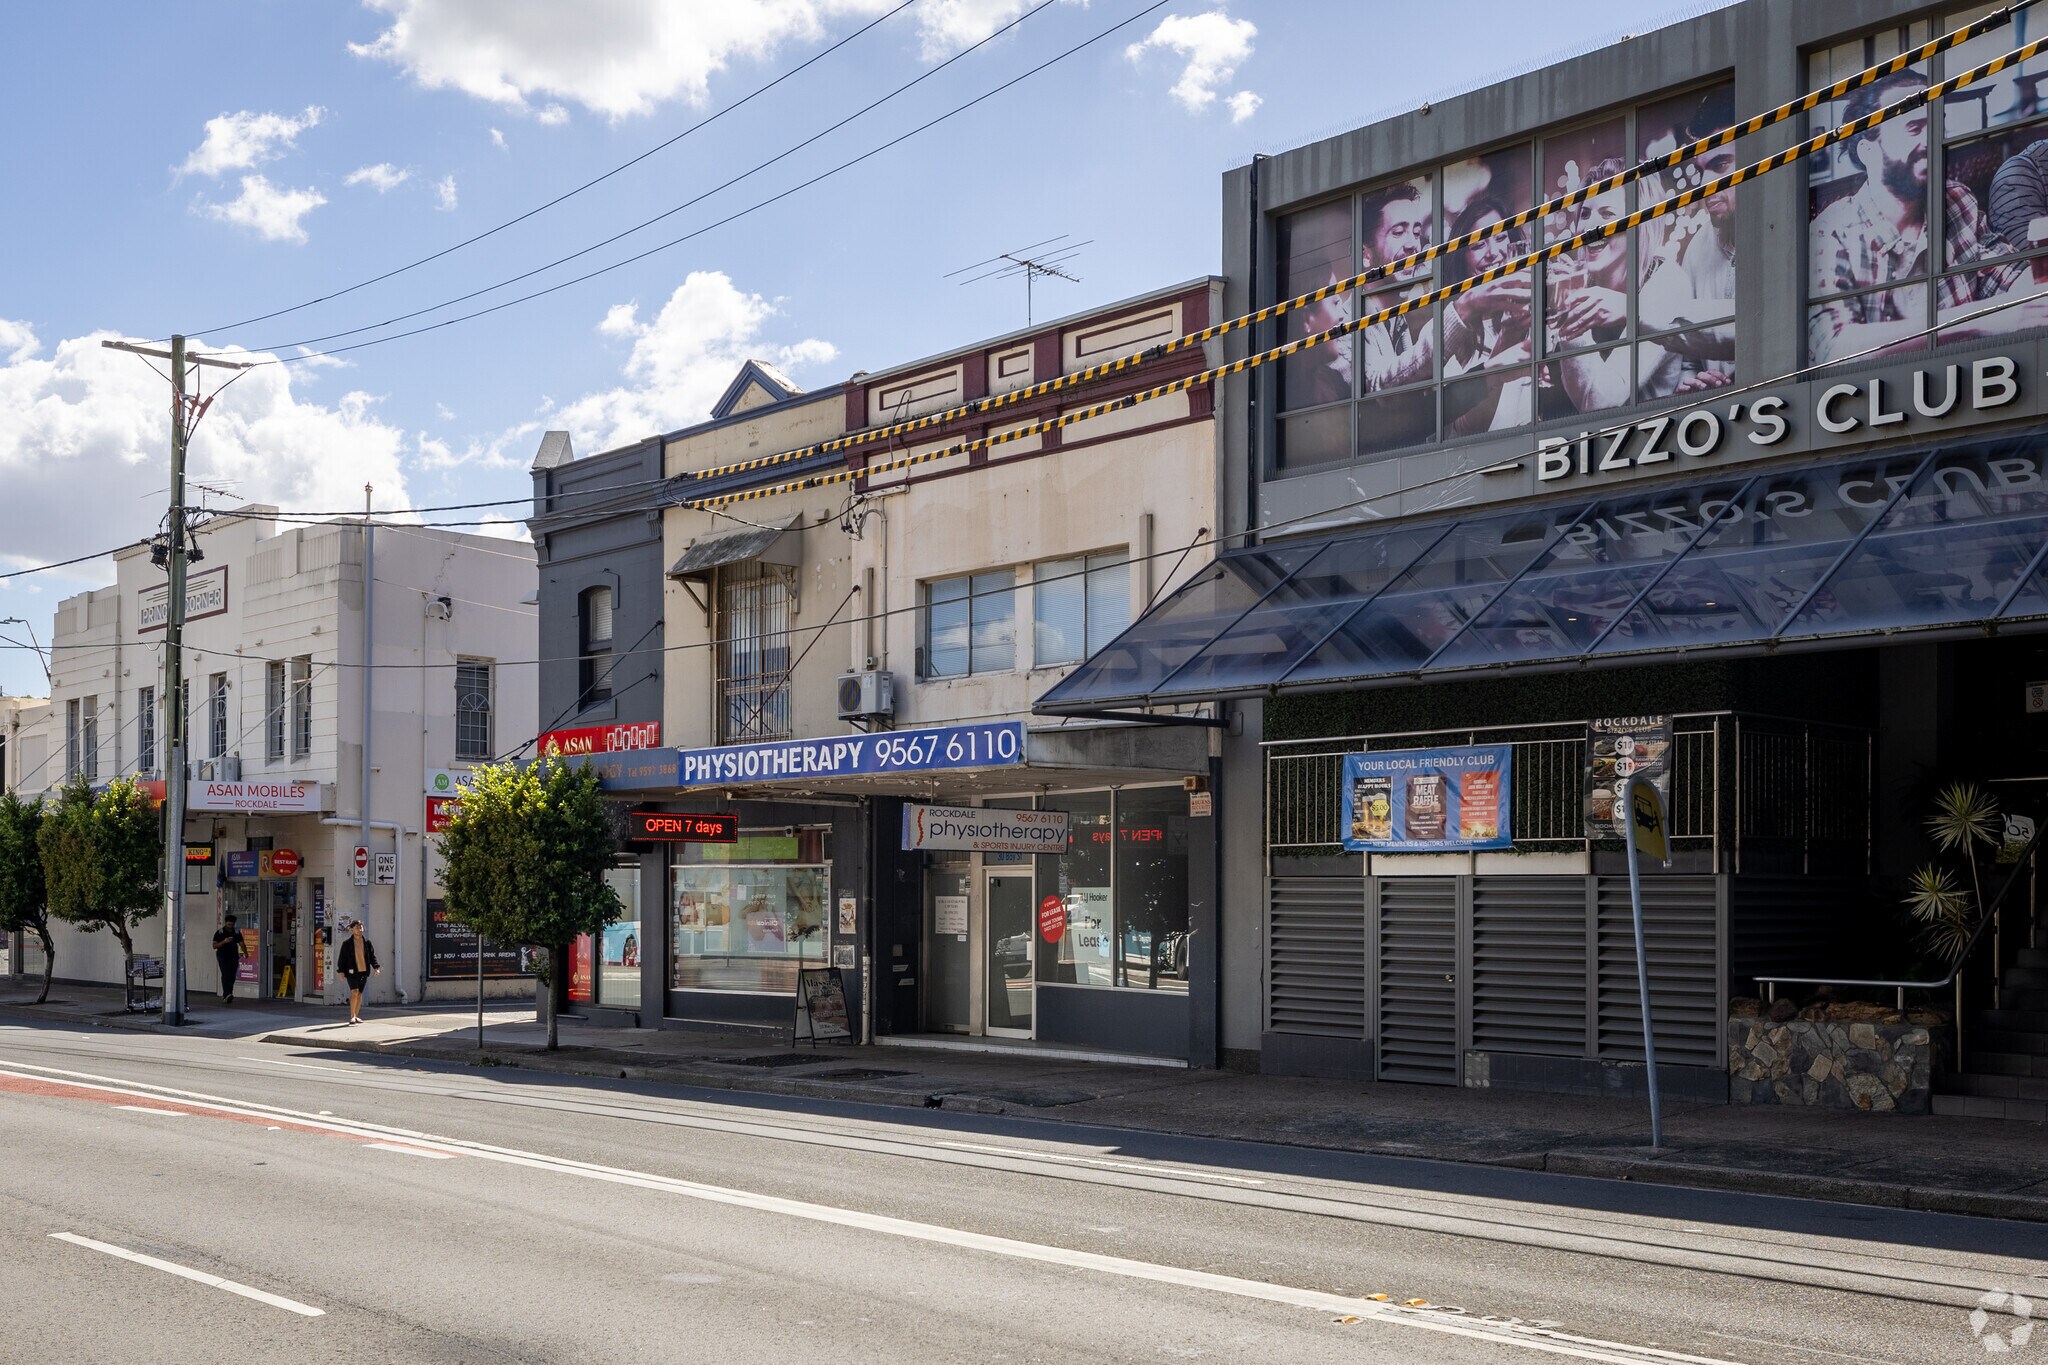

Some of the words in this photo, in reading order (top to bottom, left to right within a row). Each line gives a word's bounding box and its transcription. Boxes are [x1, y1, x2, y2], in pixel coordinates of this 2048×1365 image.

[1538, 396, 1790, 482] BIZZO'S
[1817, 355, 2021, 434] CLUB
[1595, 715, 1664, 727] ROCKDALE
[563, 735, 593, 753] ASAN
[685, 741, 864, 781] PHYSIOTHERAPY
[876, 734, 939, 767] 9567
[946, 729, 1017, 762] 6110
[1358, 760, 1384, 771] YOUR
[1386, 759, 1417, 770] LOCAL
[1419, 757, 1464, 768] FRIENDLY
[1467, 755, 1495, 765] CLUB
[207, 784, 243, 797] ASAN
[247, 785, 305, 798] MOBILES
[1415, 784, 1437, 795] MEAT
[235, 800, 278, 809] ROCKDALE
[1413, 795, 1439, 806] RAFFLE
[929, 808, 976, 819] ROCKDALE
[1016, 813, 1039, 823] 9567
[1041, 814, 1063, 824] 6110
[645, 818, 682, 832] OPEN
[685, 820, 693, 832] 7
[695, 820, 723, 836] days
[930, 820, 1065, 843] physiotherapy
[980, 842, 1009, 850] SPORTS
[1037, 843, 1065, 851] CENTRE
[1443, 839, 1473, 847] WELCOME
[378, 856, 394, 864] ONE
[1089, 892, 1108, 901] Hooker
[1041, 910, 1050, 918] FOR
[1049, 906, 1062, 916] LEASE
[1084, 915, 1102, 929] For
